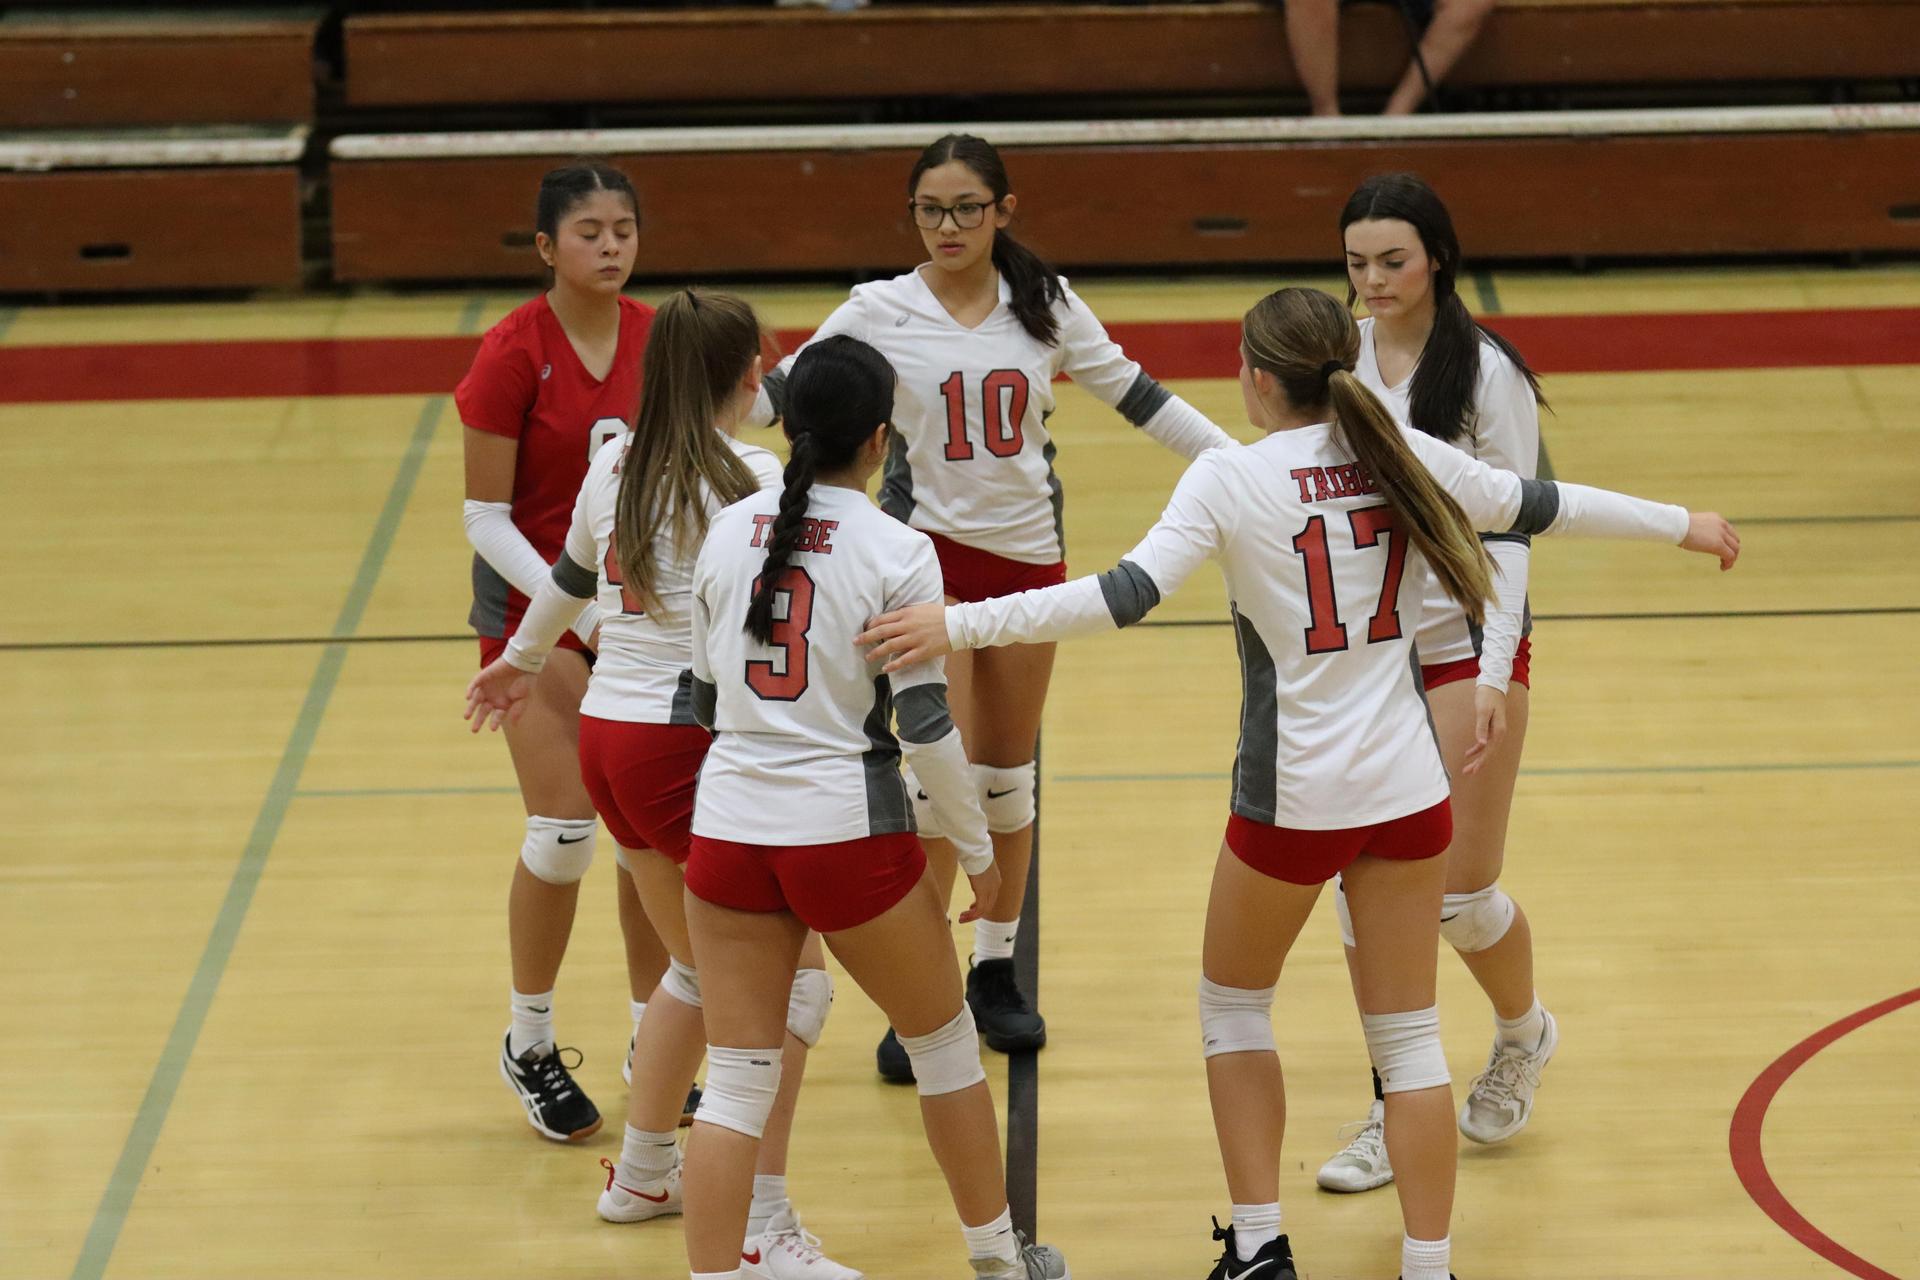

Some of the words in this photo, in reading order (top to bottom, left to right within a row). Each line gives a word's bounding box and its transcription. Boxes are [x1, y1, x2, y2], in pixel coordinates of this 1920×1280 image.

[940, 368, 1030, 461] 10
[750, 513, 840, 555] TBE
[1292, 503, 1410, 655] 17
[744, 565, 816, 702] 3
